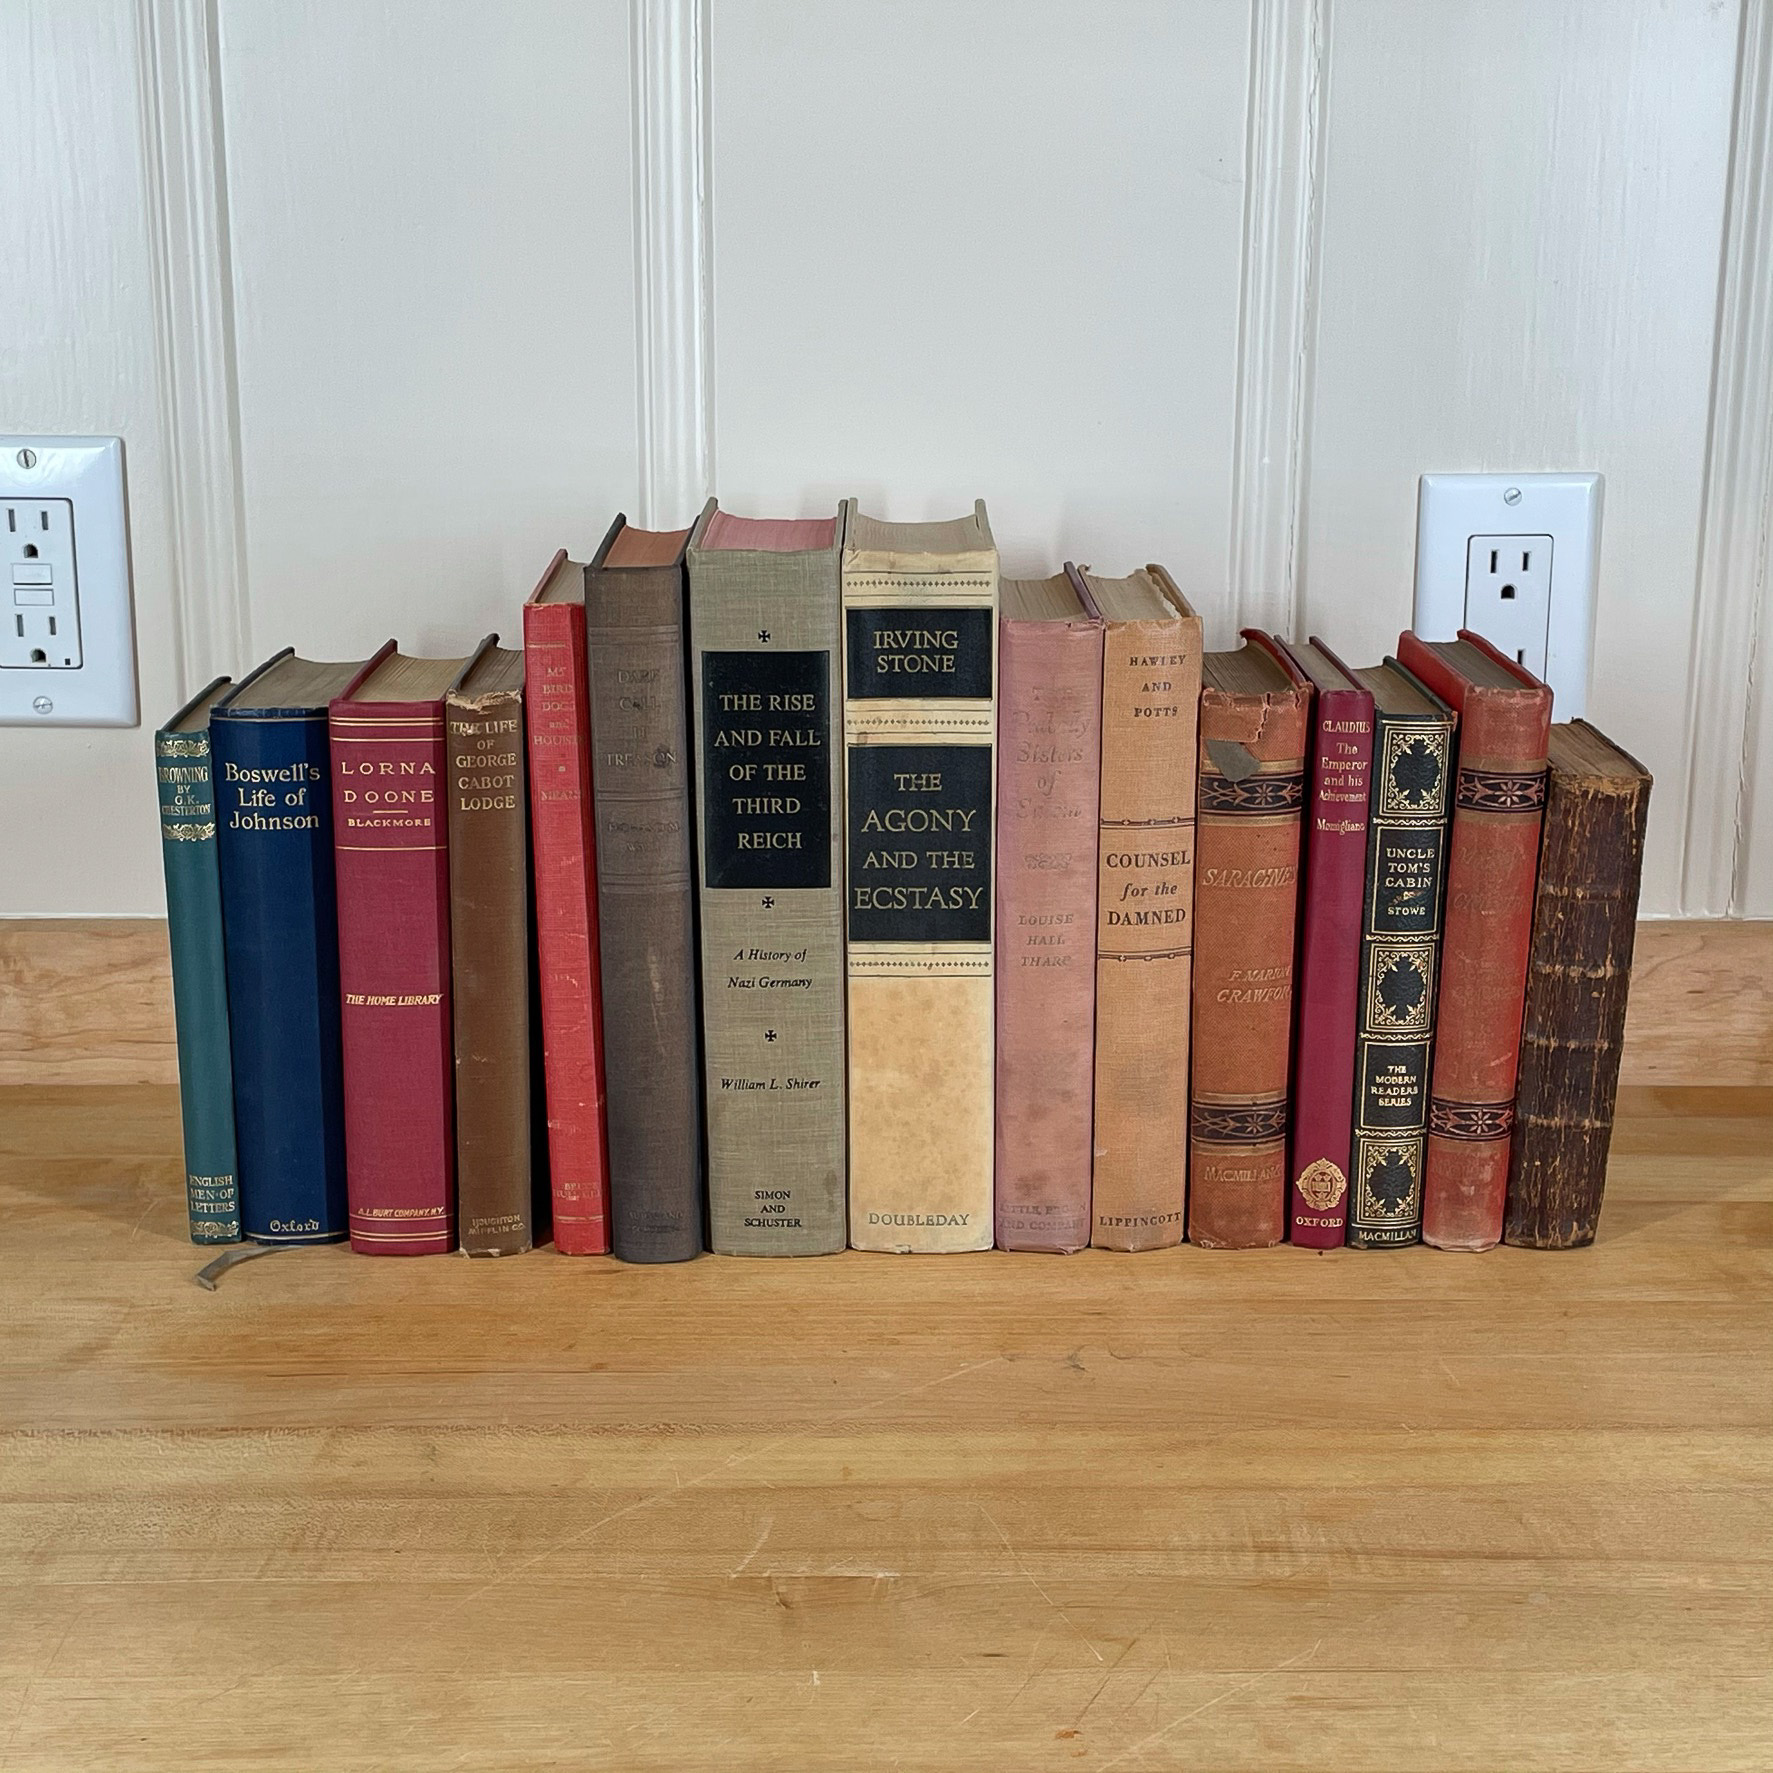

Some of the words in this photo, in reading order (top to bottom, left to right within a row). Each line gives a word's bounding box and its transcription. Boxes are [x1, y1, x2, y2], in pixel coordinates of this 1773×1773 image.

[874, 631, 959, 649] IRVING
[877, 654, 955, 673] STONE
[1130, 655, 1186, 666] HAWLEY
[1142, 682, 1172, 692] AND
[720, 694, 762, 710] THE
[769, 694, 816, 711] RISE
[1134, 706, 1178, 718] POTTS
[485, 720, 518, 734] LIFE
[1322, 720, 1370, 733] CLAUDIUS
[714, 730, 762, 746] AND
[769, 730, 820, 746] FALL
[477, 740, 495, 750] OF
[1336, 742, 1358, 754] The
[456, 753, 516, 768] GEORGE
[1322, 757, 1368, 772] Emperor
[158, 766, 208, 783] BROWNING
[225, 762, 320, 782] Boswell's
[342, 762, 435, 774] LORNA
[729, 764, 757, 780] OF
[763, 764, 806, 780] THE
[458, 775, 514, 789] CABOT
[894, 773, 942, 791] THE
[1324, 775, 1344, 786] and
[1348, 774, 1362, 786] his
[177, 784, 191, 794] BY
[238, 788, 276, 806] Life
[285, 788, 306, 806] of
[344, 790, 434, 803] DOONE
[1320, 790, 1366, 802] Achievement
[461, 796, 515, 810] LODGE
[732, 798, 800, 814] THIRD
[162, 804, 211, 816] CHESTERTON
[230, 811, 320, 830] Johnson
[348, 818, 431, 827] BLACKMORE
[861, 809, 976, 832] AGONY
[1316, 818, 1365, 835] Momigliano
[738, 832, 802, 849] REICH
[1106, 850, 1190, 868] COUNSEL
[1386, 848, 1434, 858] UNCLE
[863, 851, 917, 869] AND
[926, 852, 975, 869] THE
[1388, 863, 1430, 873] TOM'S
[1385, 877, 1433, 888] CABIN
[854, 887, 983, 910] ECSTASY
[1120, 883, 1148, 902] for
[1154, 882, 1178, 895] the
[1108, 908, 1186, 926] DAMNED
[1388, 907, 1426, 916] STOWE
[1018, 914, 1074, 926] LOUISE
[1027, 936, 1064, 946] HALL
[734, 950, 744, 960] A
[748, 949, 791, 962] History
[794, 949, 807, 962] of
[1021, 956, 1071, 967] THARP
[728, 977, 755, 988] Nazi
[758, 977, 812, 989] Germany
[346, 994, 365, 1005] THE
[366, 996, 396, 1006] HOME
[398, 994, 444, 1006] LIBRARY
[1217, 984, 1292, 1003] CRAWFOR
[1388, 1066, 1406, 1074] THE
[721, 1078, 765, 1090] William
[770, 1079, 782, 1090] L.
[786, 1078, 820, 1090] Shirer
[1376, 1075, 1416, 1084] MODERN
[1371, 1086, 1418, 1095] READERS
[1378, 1098, 1411, 1106] SERIES
[189, 1175, 232, 1187] ENGLISH
[754, 1190, 791, 1200] SIMON
[190, 1201, 235, 1214] LETTERS
[760, 1204, 785, 1213] AND
[270, 1219, 319, 1232] Oxford
[744, 1218, 802, 1228] SCHUSTER
[869, 1212, 970, 1226] DOUBLEDAY
[1100, 1212, 1182, 1227] LIPPINCOTT
[1296, 1216, 1344, 1228] OXFORD
[1358, 1229, 1417, 1241] MACMILLAN
